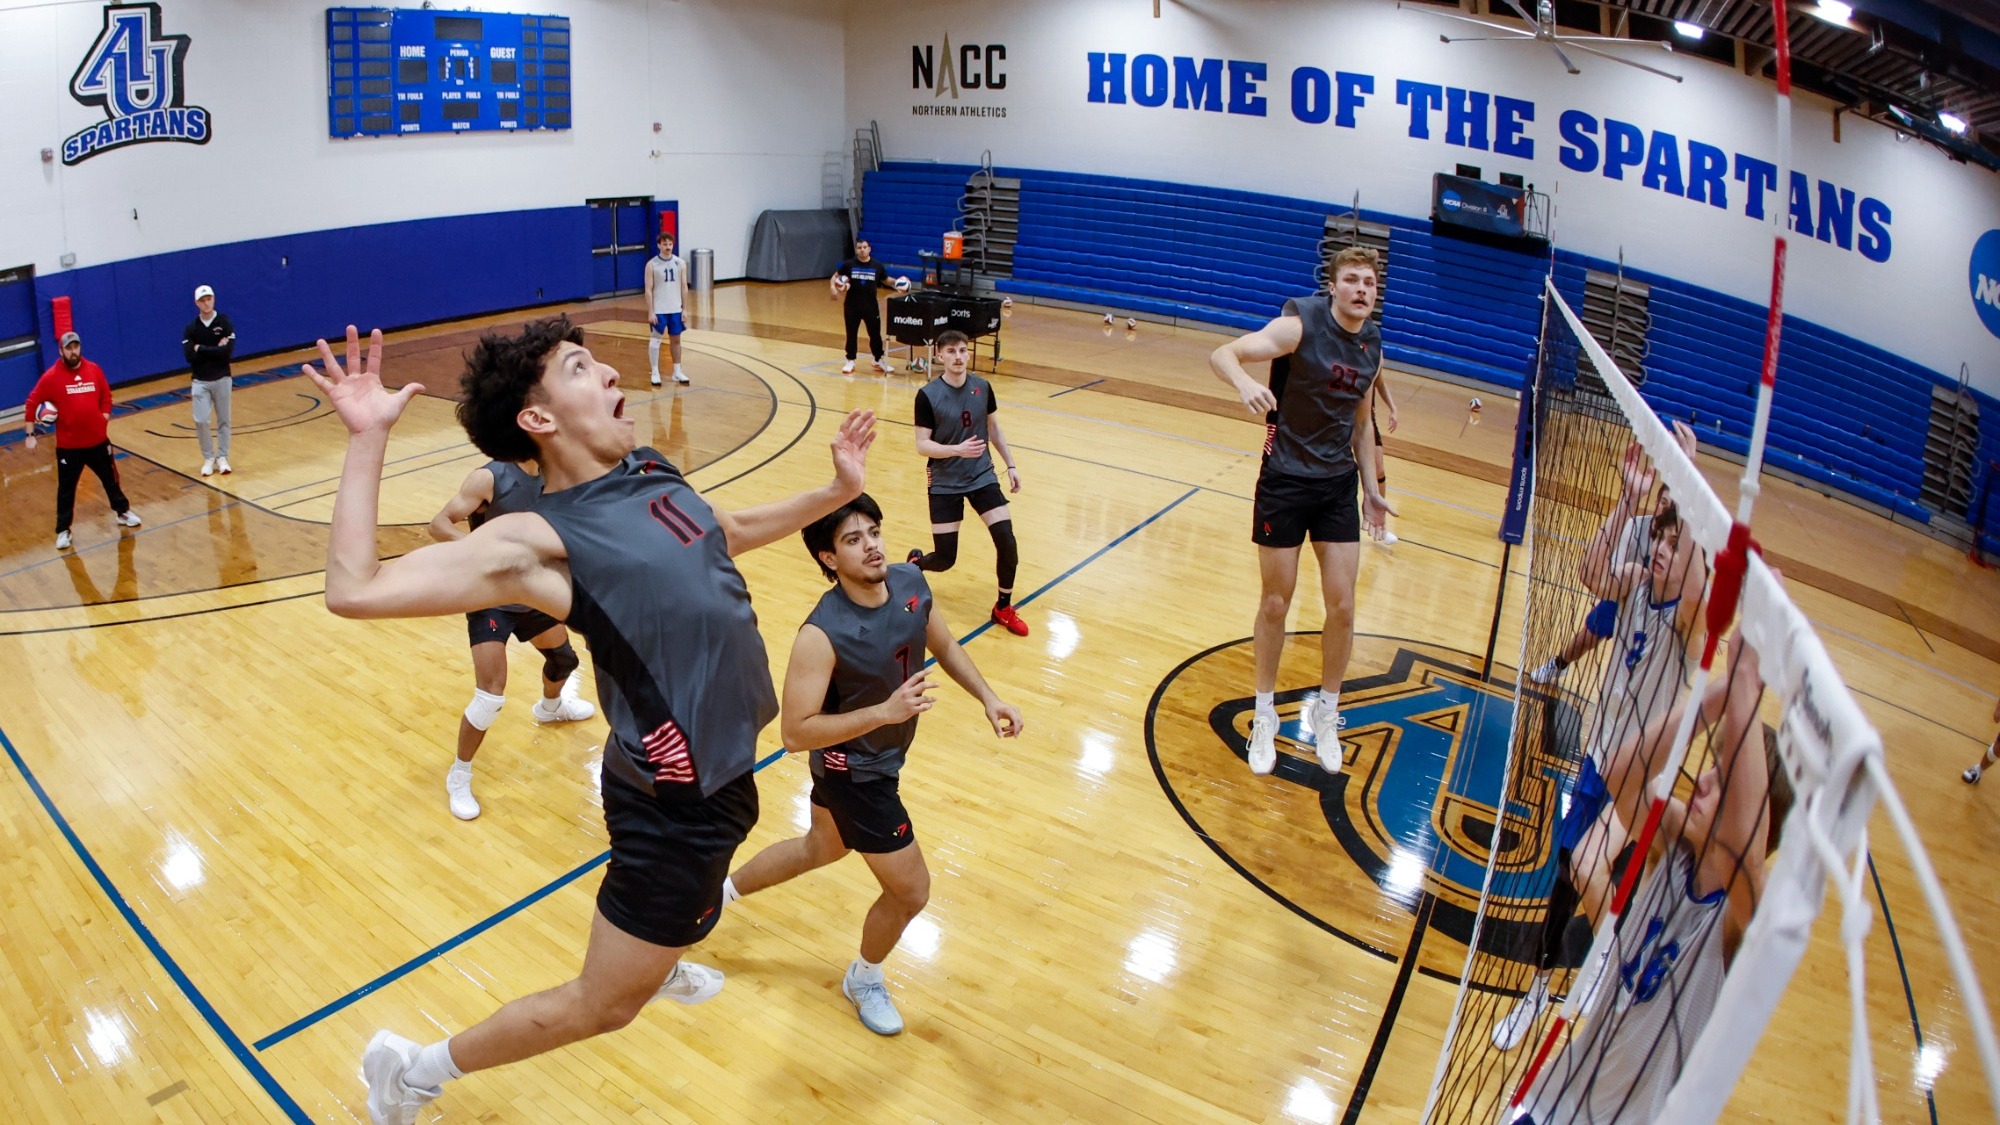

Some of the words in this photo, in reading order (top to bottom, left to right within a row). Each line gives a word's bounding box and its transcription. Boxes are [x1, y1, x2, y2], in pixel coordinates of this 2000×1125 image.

[400, 46, 425, 57] HOME
[450, 49, 469, 57] PERIOD
[490, 47, 516, 59] GUEST
[912, 31, 1007, 99] NACC
[912, 105, 957, 116] NORTHERN
[959, 106, 1007, 118] ATHLETICS
[64, 107, 207, 162] SPARTANS
[1087, 52, 1267, 117] HOME
[1291, 66, 1374, 129] OF
[1396, 78, 1535, 160] THE
[1558, 109, 1892, 263] SPARTANS
[1443, 198, 1461, 208] NCAA
[663, 267, 676, 283] 11
[893, 316, 923, 326] molten
[961, 410, 973, 428] 8
[650, 494, 705, 546] 11
